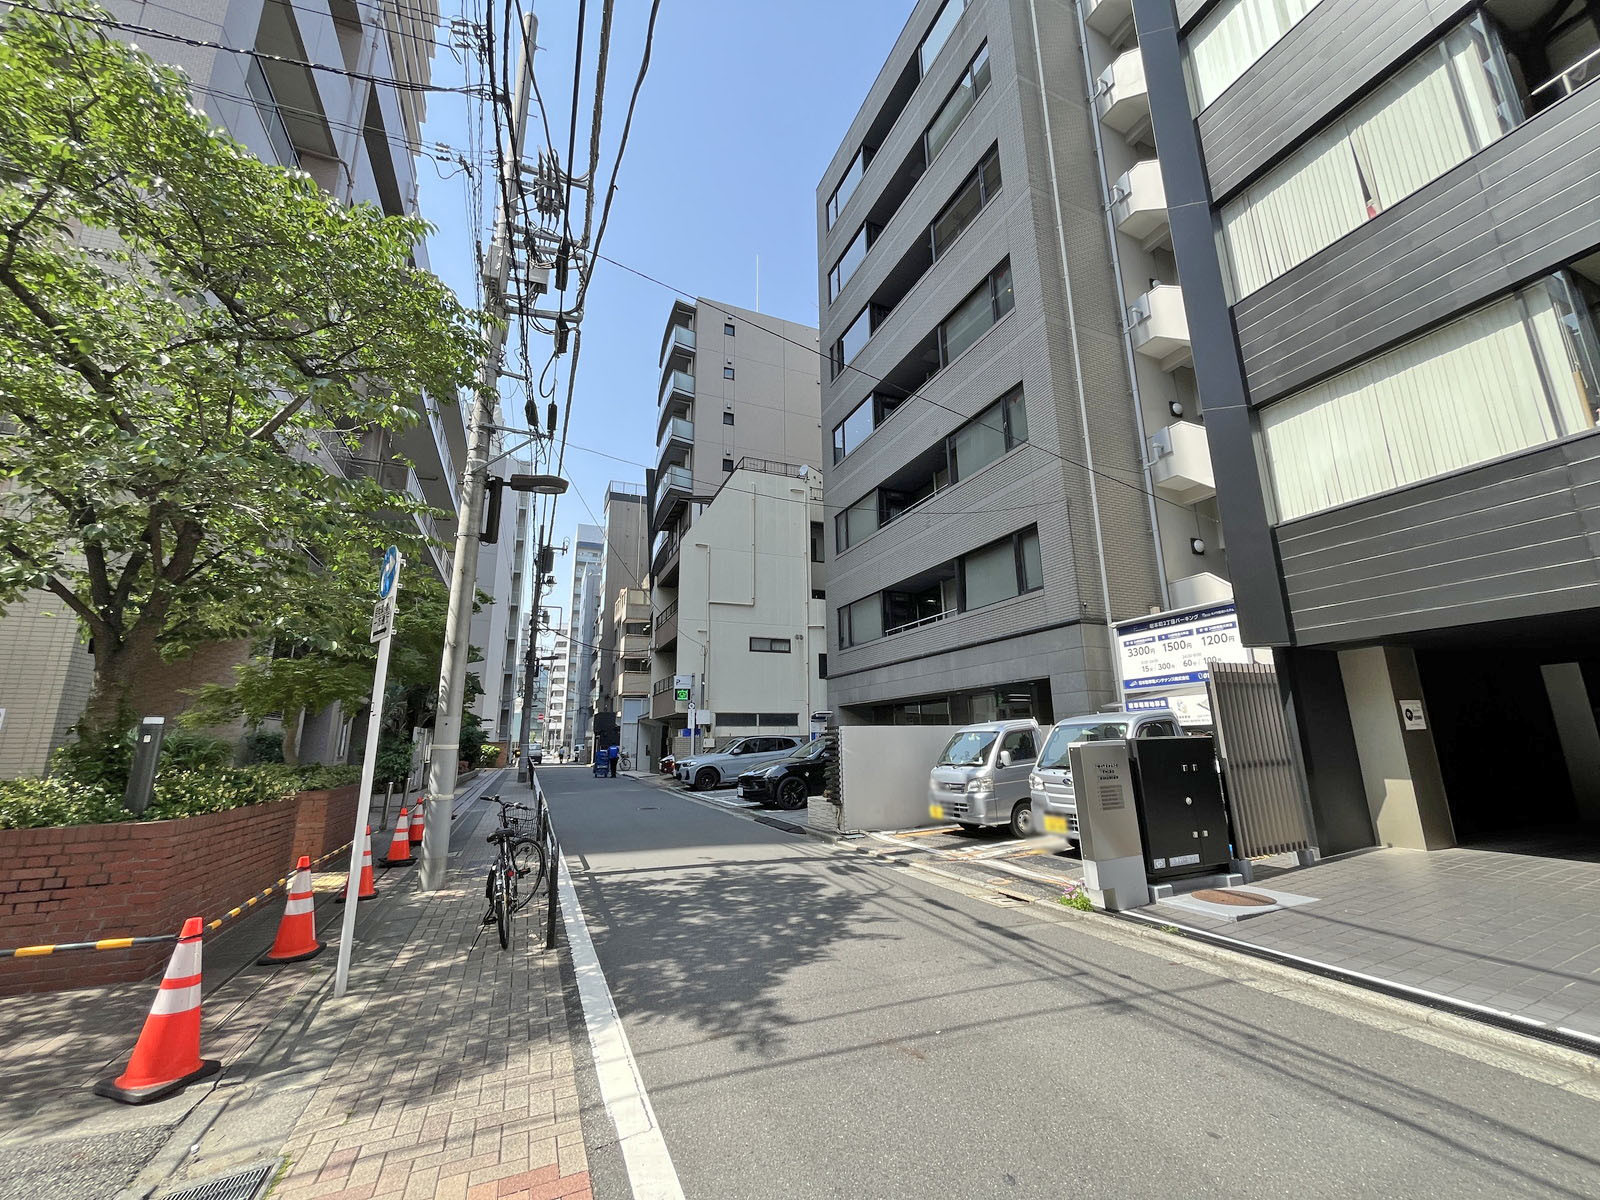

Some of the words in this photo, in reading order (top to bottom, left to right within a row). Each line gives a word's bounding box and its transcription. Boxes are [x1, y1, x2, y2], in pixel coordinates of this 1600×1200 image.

[1201, 633, 1235, 646] 1200円
[1128, 646, 1155, 658] 3300円
[1162, 640, 1192, 653] 1500円
